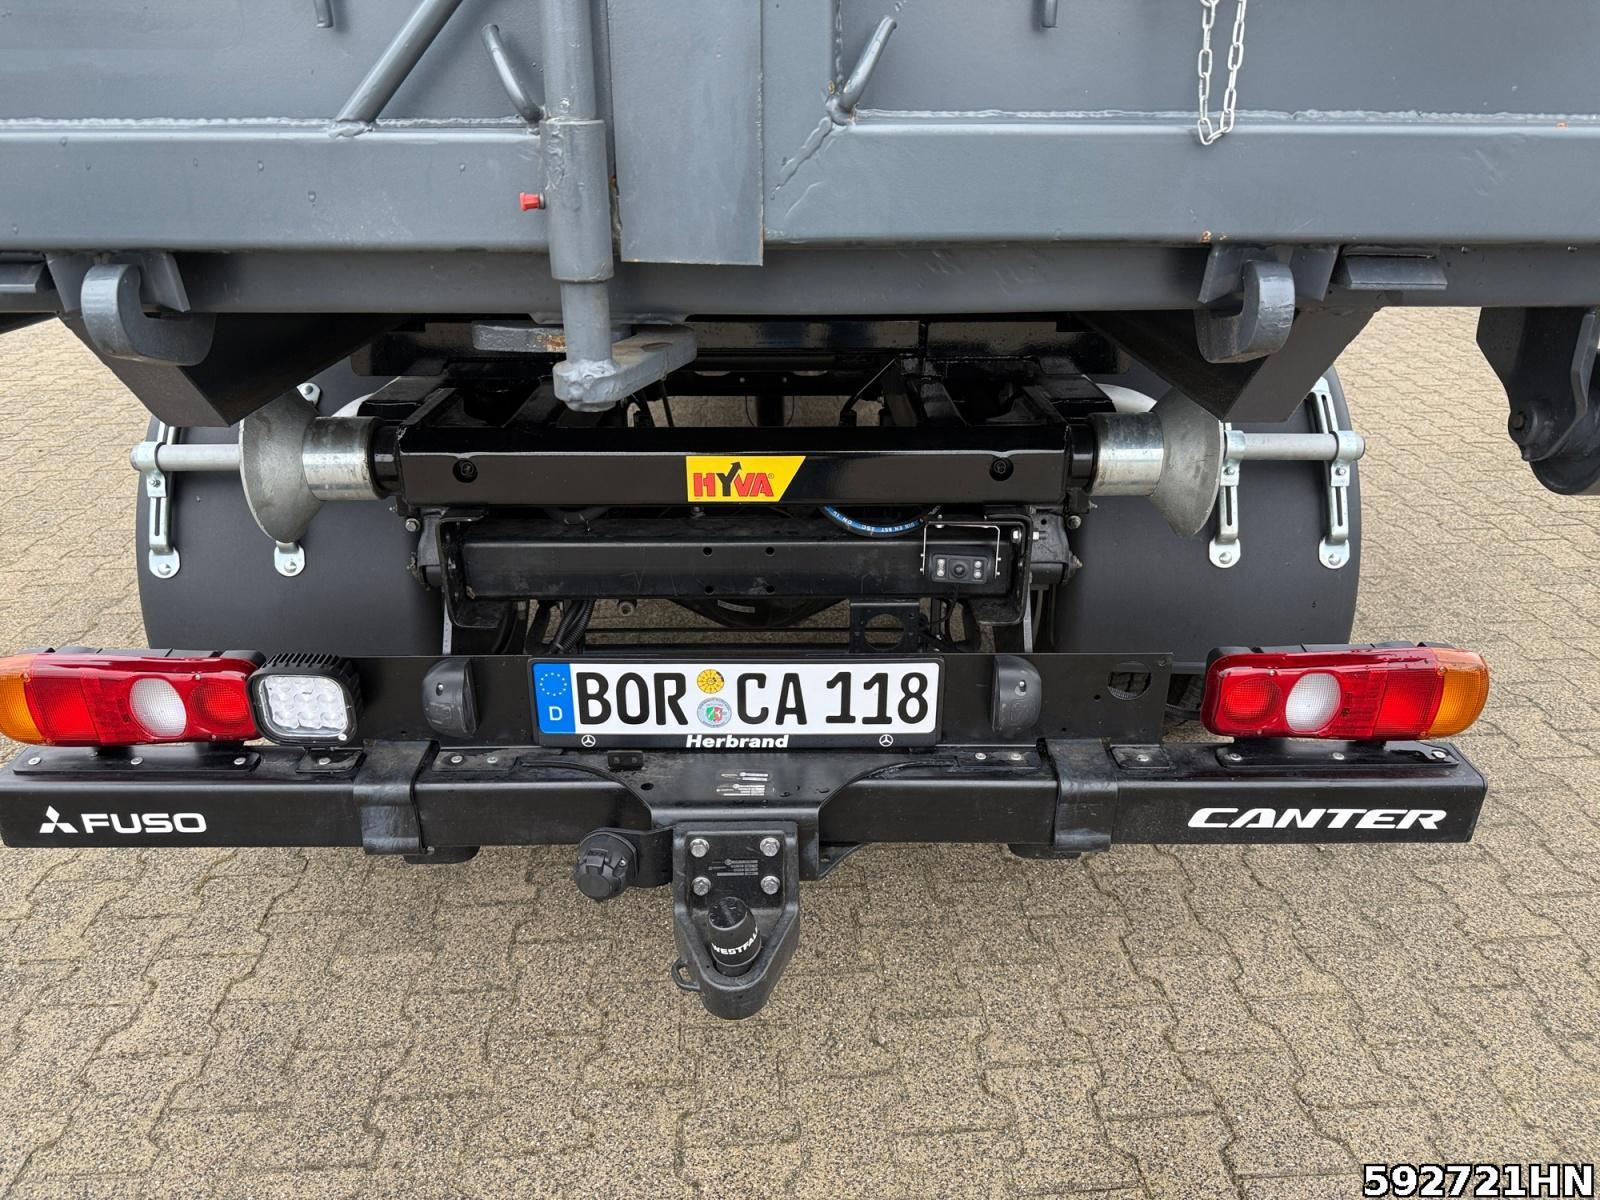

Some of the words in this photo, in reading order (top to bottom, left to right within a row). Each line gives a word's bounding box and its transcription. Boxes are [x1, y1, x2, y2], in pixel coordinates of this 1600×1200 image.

[693, 462, 774, 497] HYVA
[576, 672, 688, 726] BOR
[737, 672, 807, 726] CA
[826, 671, 928, 724] 118
[548, 706, 562, 721] D
[686, 735, 788, 749] Herbrand
[80, 812, 207, 834] FUSO
[1187, 807, 1447, 830] CANTER
